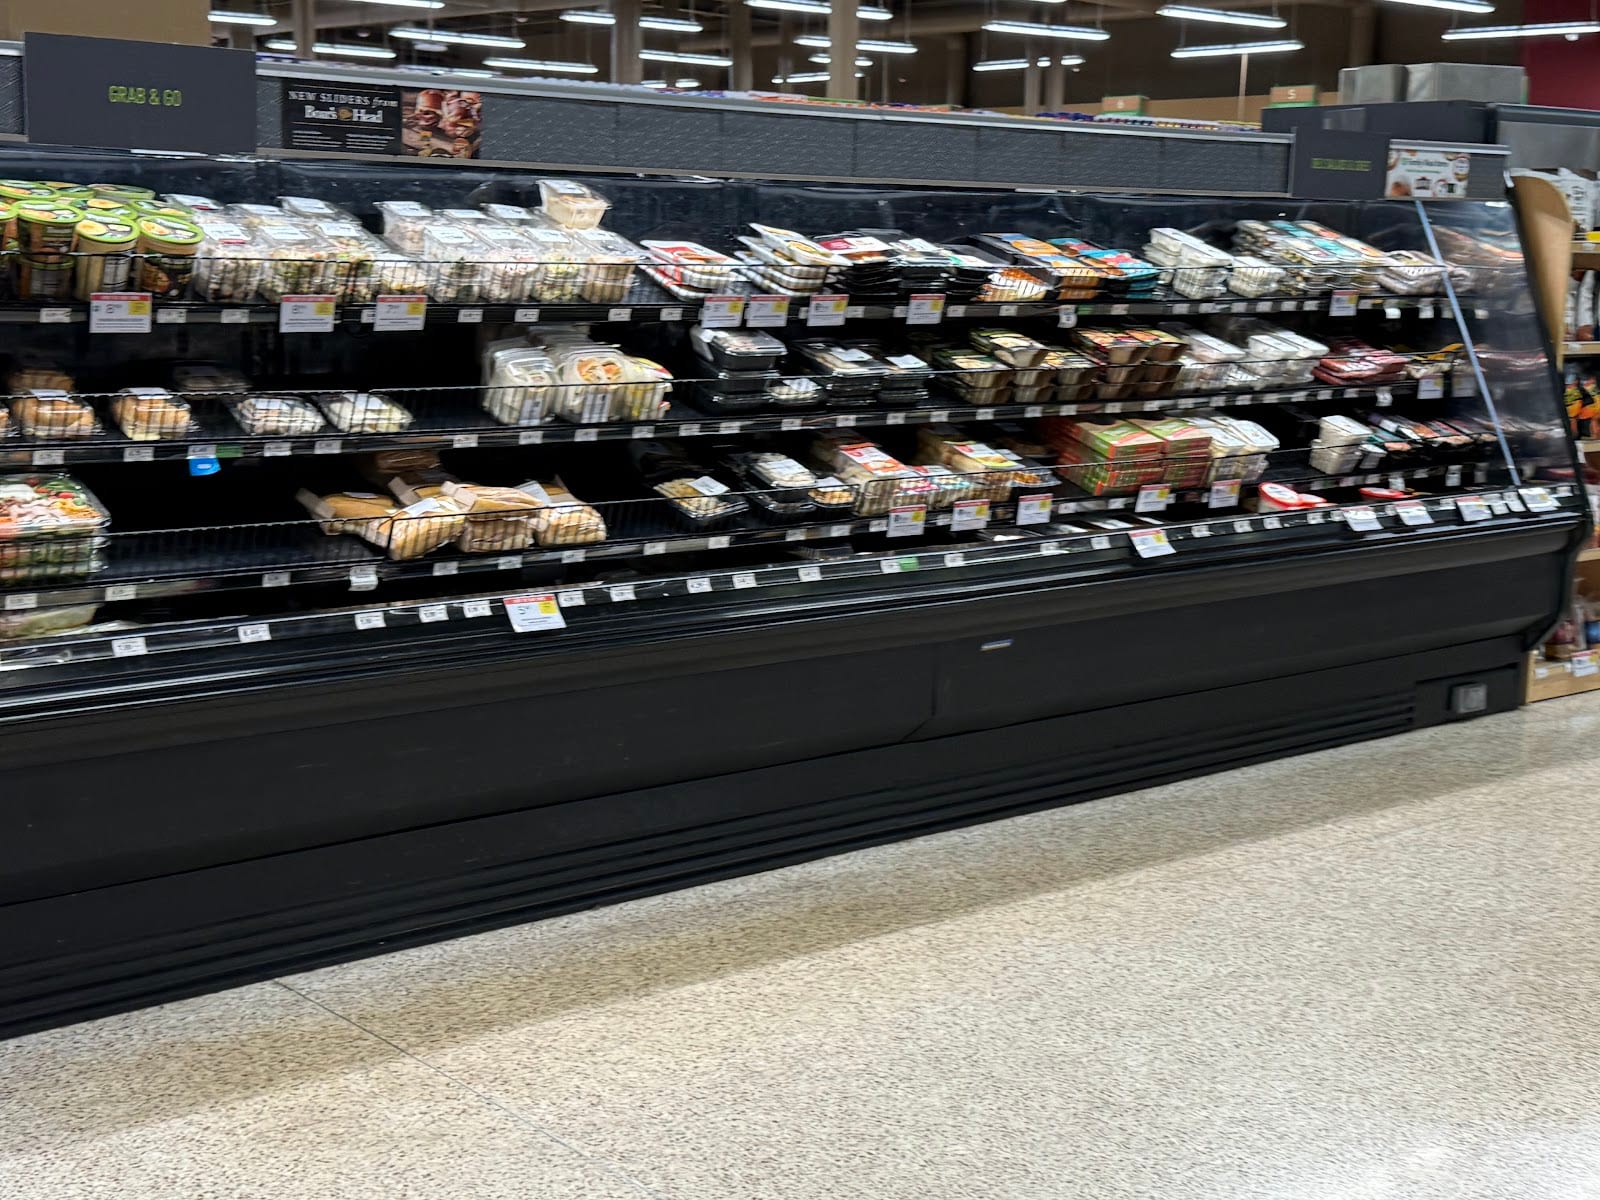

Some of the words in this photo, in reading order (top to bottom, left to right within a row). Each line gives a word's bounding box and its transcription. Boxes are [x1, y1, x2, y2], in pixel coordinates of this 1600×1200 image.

[109, 86, 146, 104] GRAB
[149, 88, 161, 105] &
[163, 90, 182, 107] GO
[288, 90, 317, 101] NEW
[319, 92, 370, 105] SLIDERS
